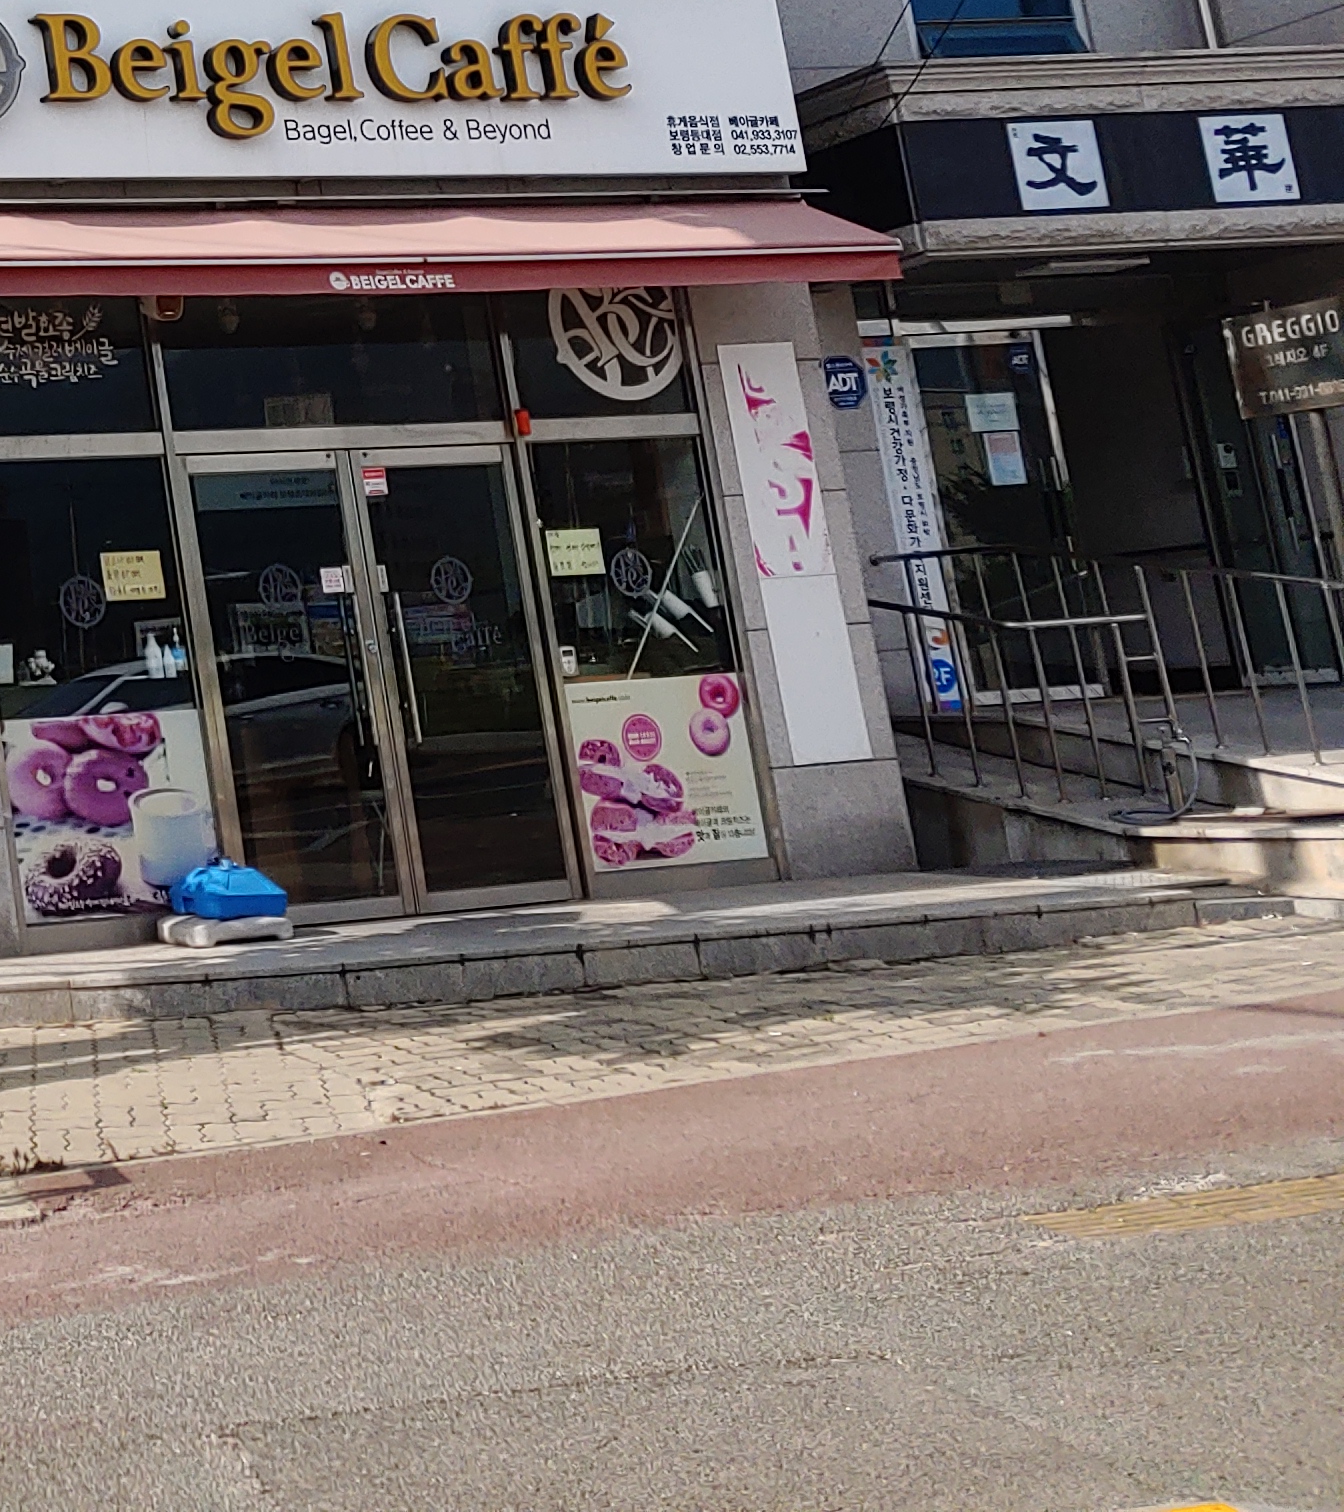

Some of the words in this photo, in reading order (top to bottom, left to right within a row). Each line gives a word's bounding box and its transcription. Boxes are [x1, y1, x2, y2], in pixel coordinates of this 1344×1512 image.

[30, 12, 365, 139] Beigel
[365, 12, 632, 102] Caffé
[443, 119, 459, 141] &
[465, 117, 552, 145] Beyond
[666, 115, 720, 128] 휴게음식점
[349, 274, 406, 290] BEIGEL
[405, 273, 456, 289] CAFFE
[1240, 309, 1340, 348] GREGGIO
[827, 372, 860, 393] ADT
